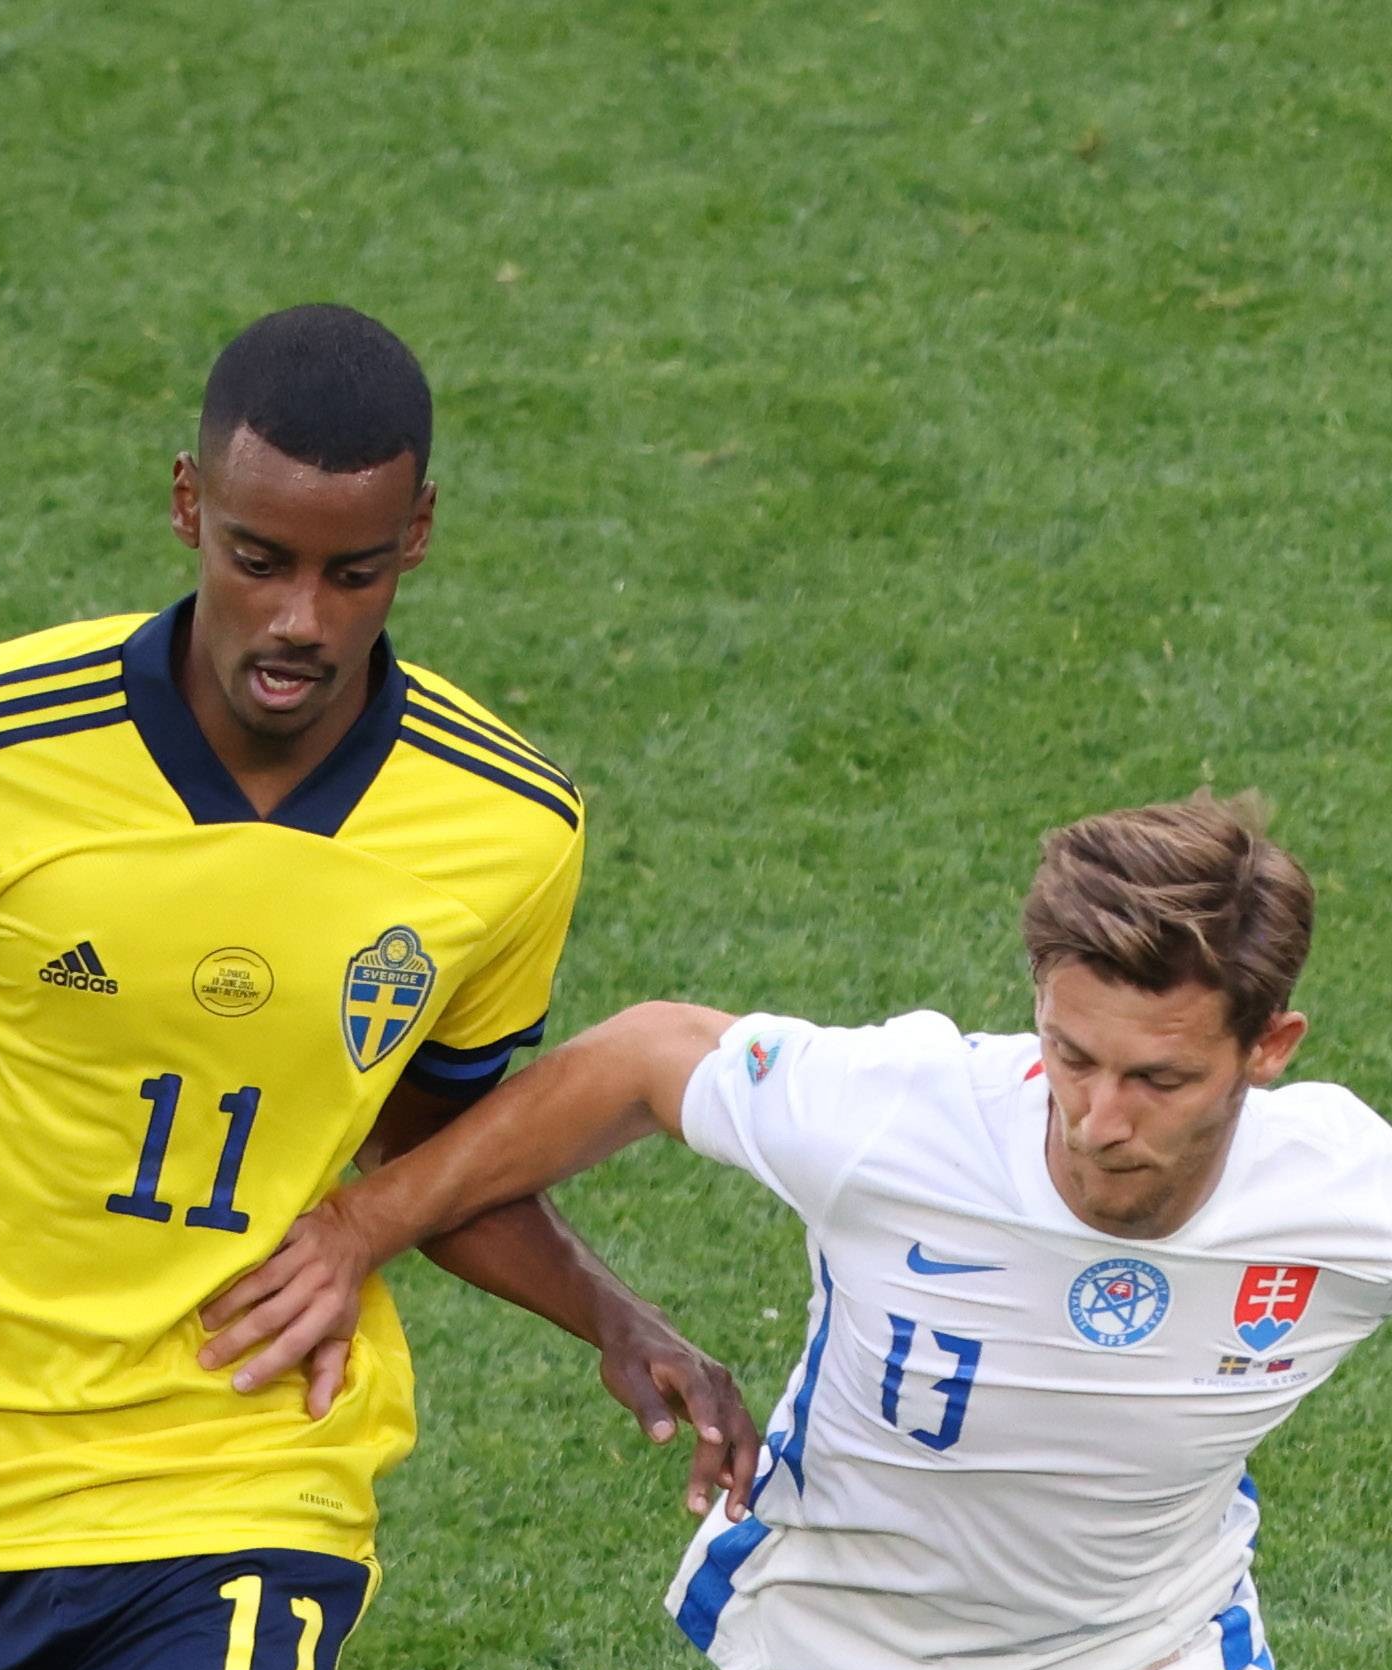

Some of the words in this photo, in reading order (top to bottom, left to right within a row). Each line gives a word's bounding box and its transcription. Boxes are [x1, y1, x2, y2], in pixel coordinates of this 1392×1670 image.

[38, 968, 119, 995] adidas
[362, 968, 419, 985] SVERIGE
[105, 1073, 262, 1234] 11
[1098, 1333, 1128, 1346] SFZ
[880, 1312, 984, 1452] 13
